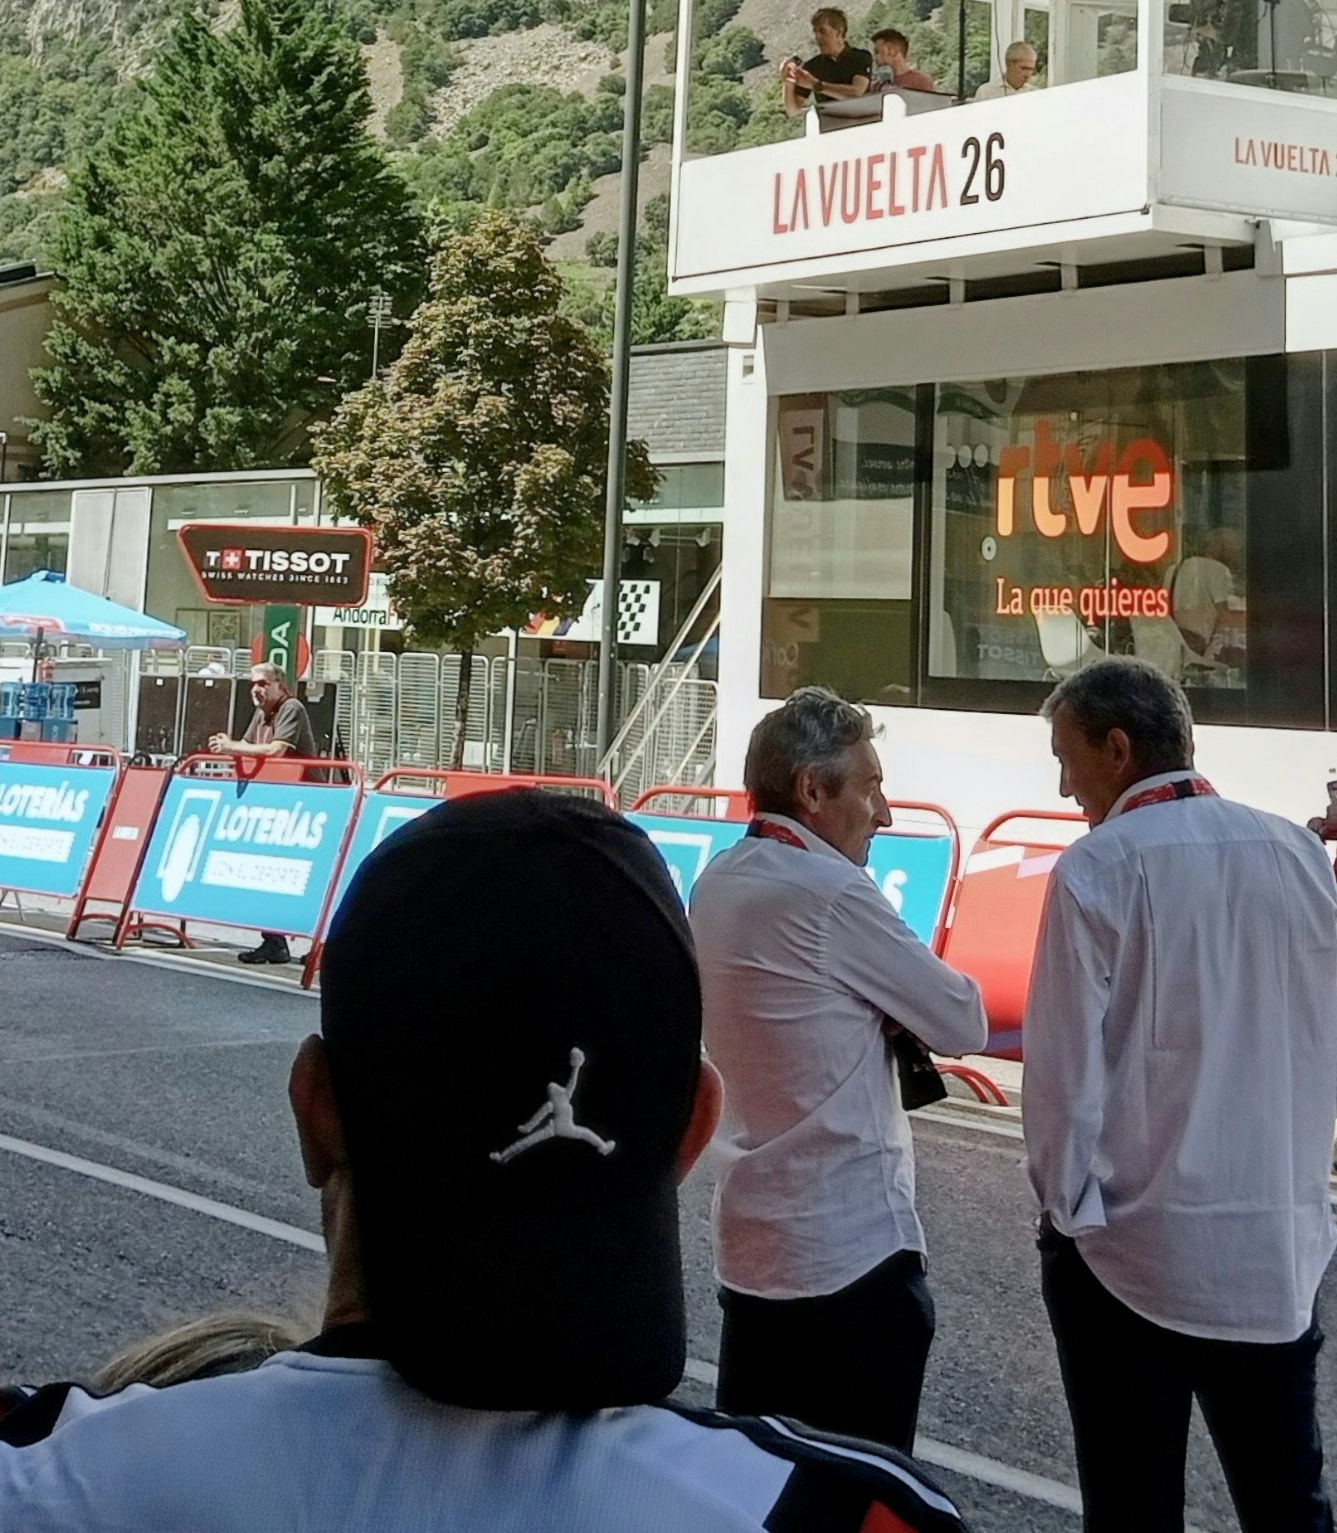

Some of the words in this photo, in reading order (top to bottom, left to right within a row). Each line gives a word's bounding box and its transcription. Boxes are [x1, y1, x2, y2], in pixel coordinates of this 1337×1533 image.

[1233, 135, 1258, 166] LA
[1261, 140, 1331, 177] VUELTA
[772, 169, 811, 236] LA
[818, 143, 949, 226] VUELTA
[959, 131, 1006, 207] 26
[996, 420, 1172, 563] rtve
[201, 570, 233, 580] SWISS
[237, 571, 285, 582] WATCHES
[289, 573, 320, 584] SINCE
[244, 549, 351, 574] TISSOT
[333, 607, 387, 625] Andorra
[996, 577, 1024, 615] La
[1030, 586, 1073, 625] que
[1079, 577, 1170, 626] quieres
[213, 800, 328, 850] LOTERÍAS
